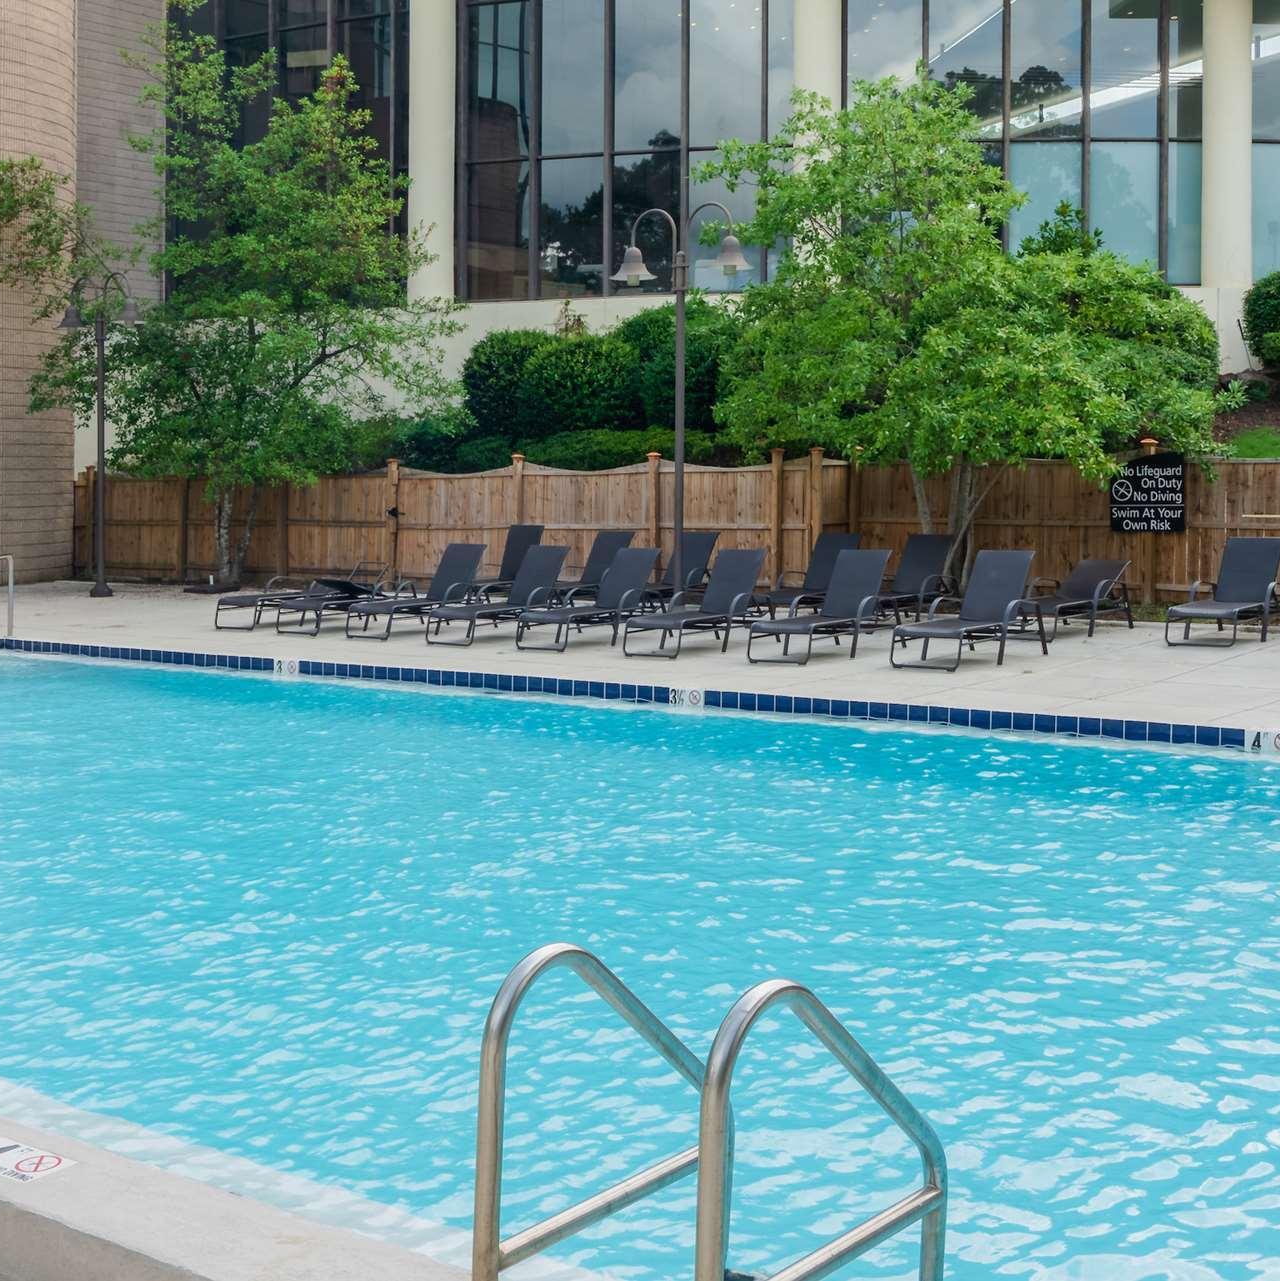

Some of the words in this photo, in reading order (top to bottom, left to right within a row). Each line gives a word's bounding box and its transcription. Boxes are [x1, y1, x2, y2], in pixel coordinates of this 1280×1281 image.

[1120, 466, 1134, 477] No
[1136, 465, 1182, 478] Lifeguard
[1141, 477, 1155, 488] On
[1158, 477, 1182, 490] Duty
[1133, 491, 1148, 501] No
[1150, 490, 1182, 503] Diving
[1112, 507, 1140, 518] Swim
[1142, 507, 1155, 518] At
[1157, 507, 1182, 518] Your
[1122, 519, 1148, 530] Own
[1150, 519, 1171, 530] Risk
[1250, 731, 1261, 749] 4
